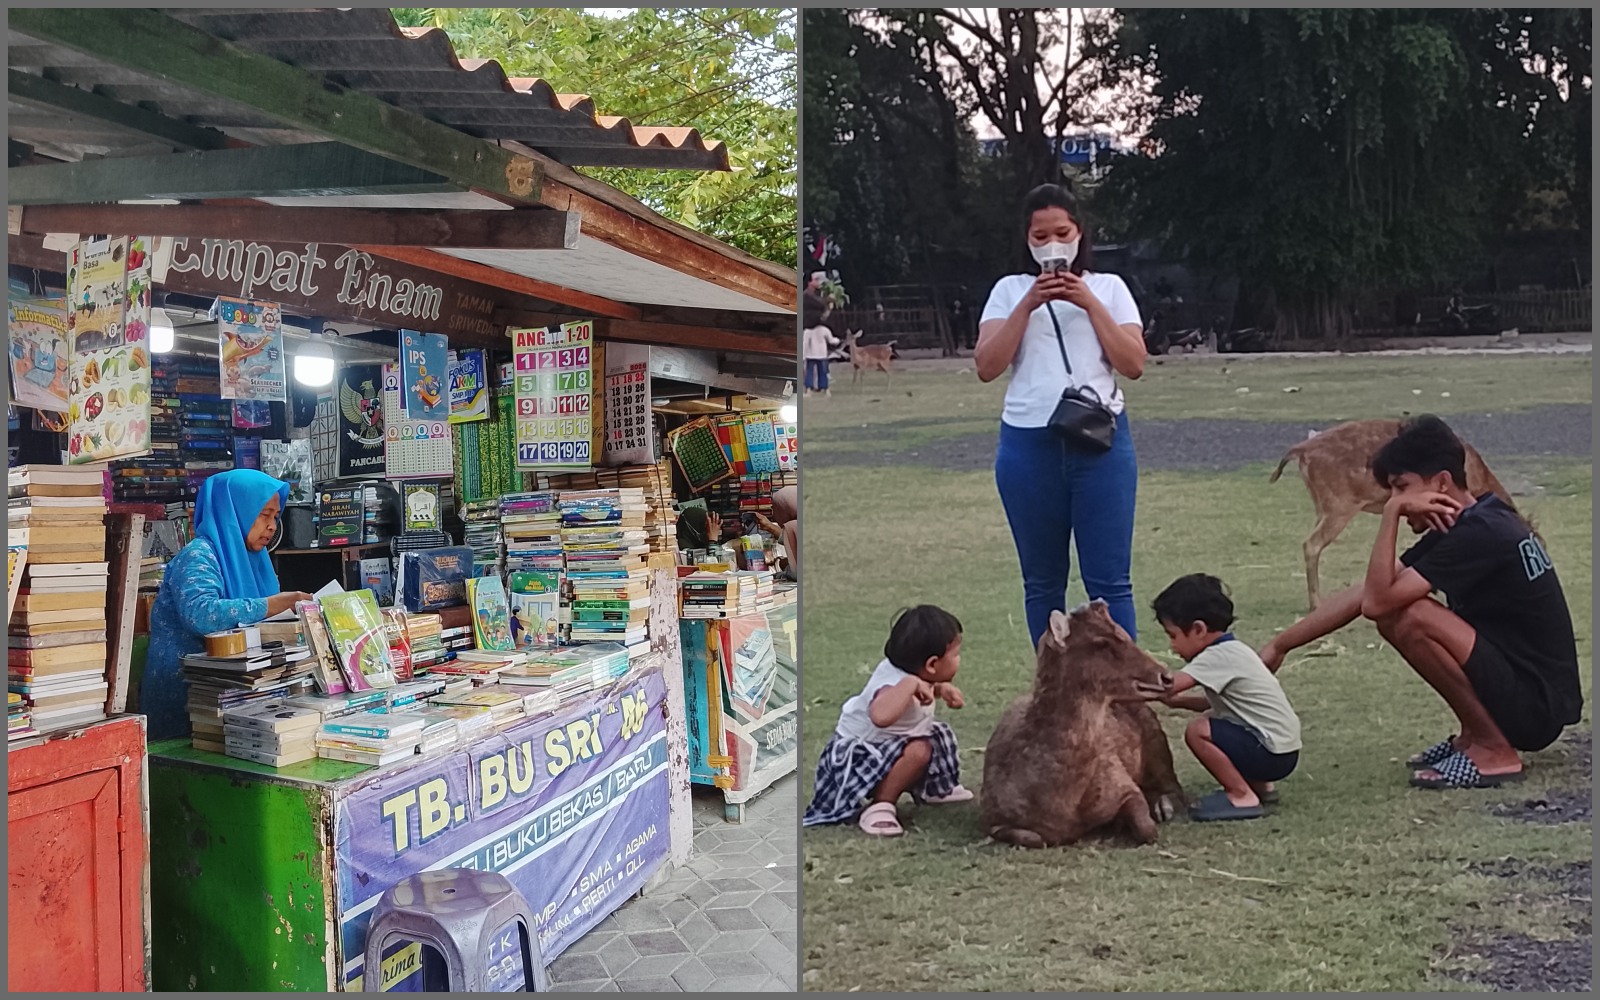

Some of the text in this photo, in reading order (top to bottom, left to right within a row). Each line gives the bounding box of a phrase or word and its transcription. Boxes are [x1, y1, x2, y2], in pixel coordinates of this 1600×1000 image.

[169, 237, 442, 320] Empat Enam
[457, 293, 494, 313] TAMAN
[13, 305, 68, 332] Informatika
[567, 325, 589, 342] 1-20
[409, 350, 425, 365] IPS
[520, 348, 588, 369] 1 2 3 4
[449, 360, 475, 379] FOKUS
[521, 376, 533, 392] 5
[561, 373, 572, 389] 7
[578, 371, 587, 387] 8
[521, 399, 534, 414] 9
[560, 396, 574, 412] 11
[576, 395, 589, 411] 12
[520, 418, 589, 436] 13 14 15 16
[520, 442, 589, 459] 17 18 19 20
[350, 456, 385, 467] PANCASI
[383, 778, 465, 852] TB.
[480, 741, 534, 810] BU
[545, 713, 604, 777] SRI
[493, 816, 548, 868] BUKU
[550, 784, 604, 834] BEKAS
[615, 748, 652, 791] BARU
[580, 860, 613, 893] SMA
[625, 823, 657, 859] AGAMA
[581, 875, 616, 912] PERTI
[381, 952, 416, 986] rima
